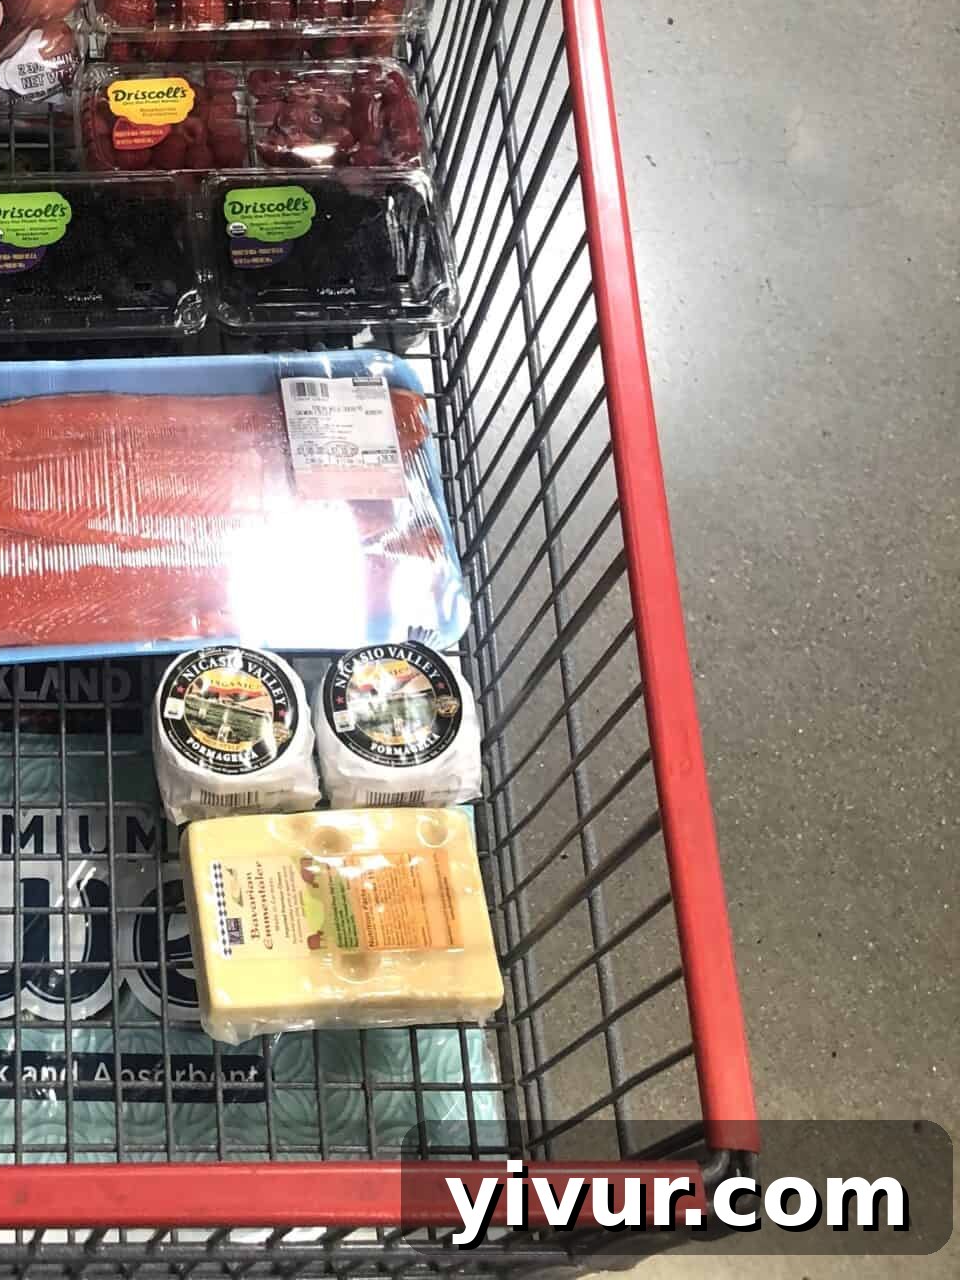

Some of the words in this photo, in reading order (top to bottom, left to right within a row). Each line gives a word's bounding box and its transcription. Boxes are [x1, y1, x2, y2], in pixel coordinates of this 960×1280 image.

[112, 86, 189, 102] Driscoll's
[228, 197, 310, 215] Driscoll's
[388, 647, 440, 678] VALLEY
[247, 662, 287, 705] VALLEY
[22, 1058, 78, 1084] and
